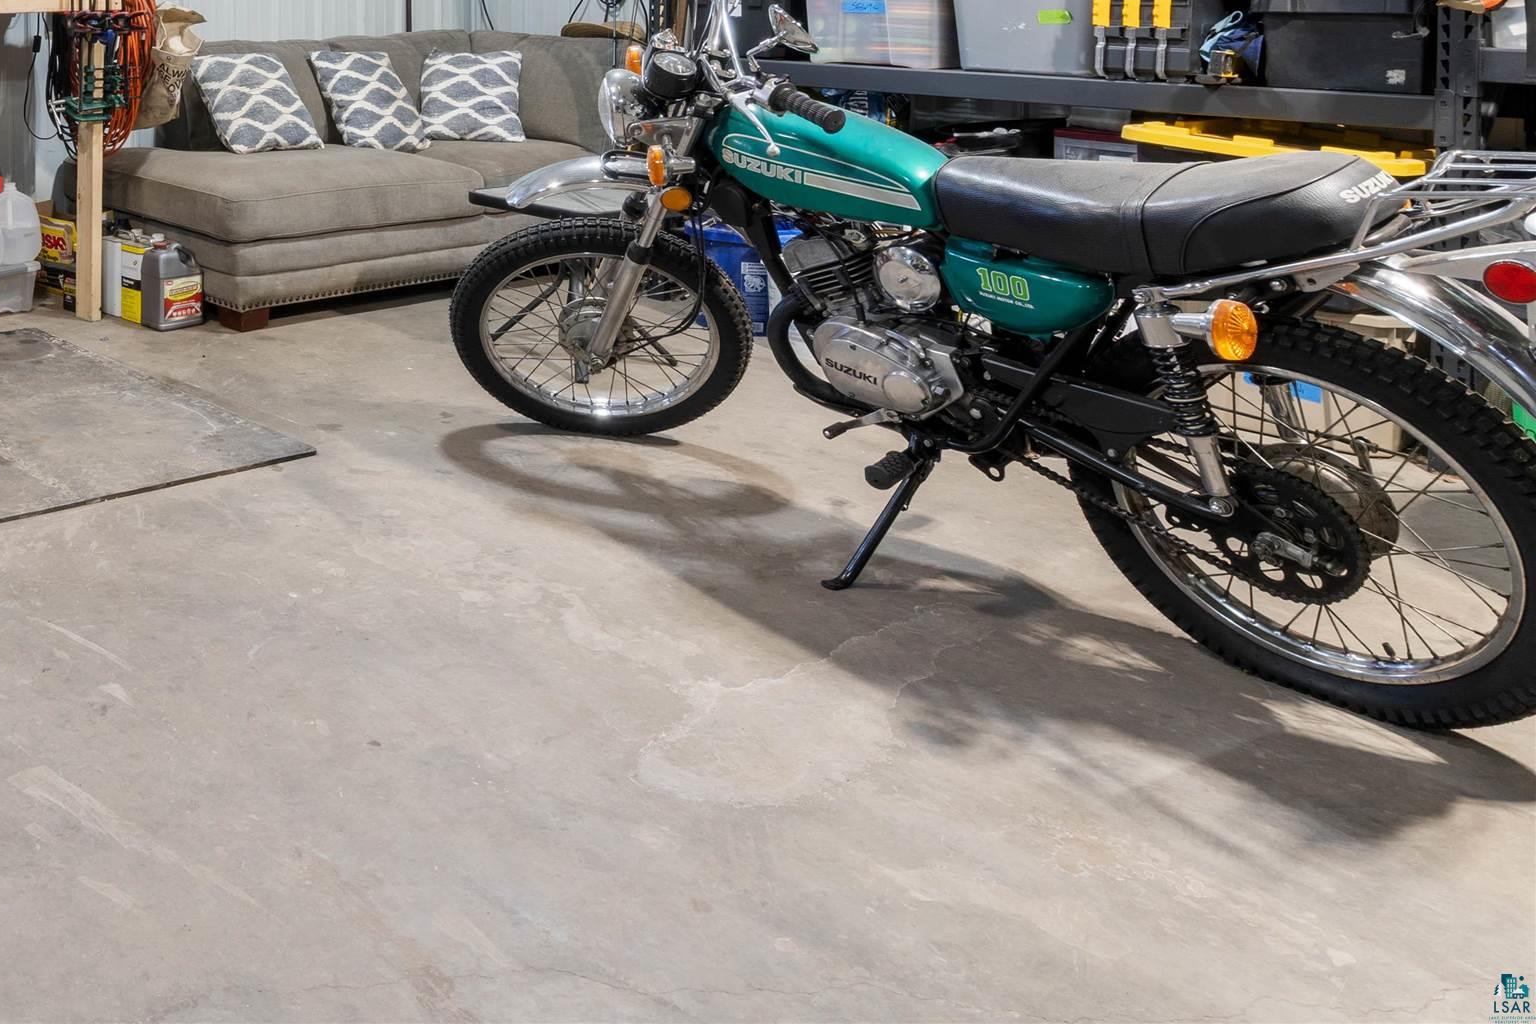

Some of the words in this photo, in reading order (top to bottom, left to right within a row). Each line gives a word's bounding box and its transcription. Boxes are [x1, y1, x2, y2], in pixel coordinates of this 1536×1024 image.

[722, 148, 802, 184] SUZUKI
[1339, 170, 1395, 203] SUZUK
[976, 267, 1030, 301] 100
[825, 357, 877, 385] SUZUKI
